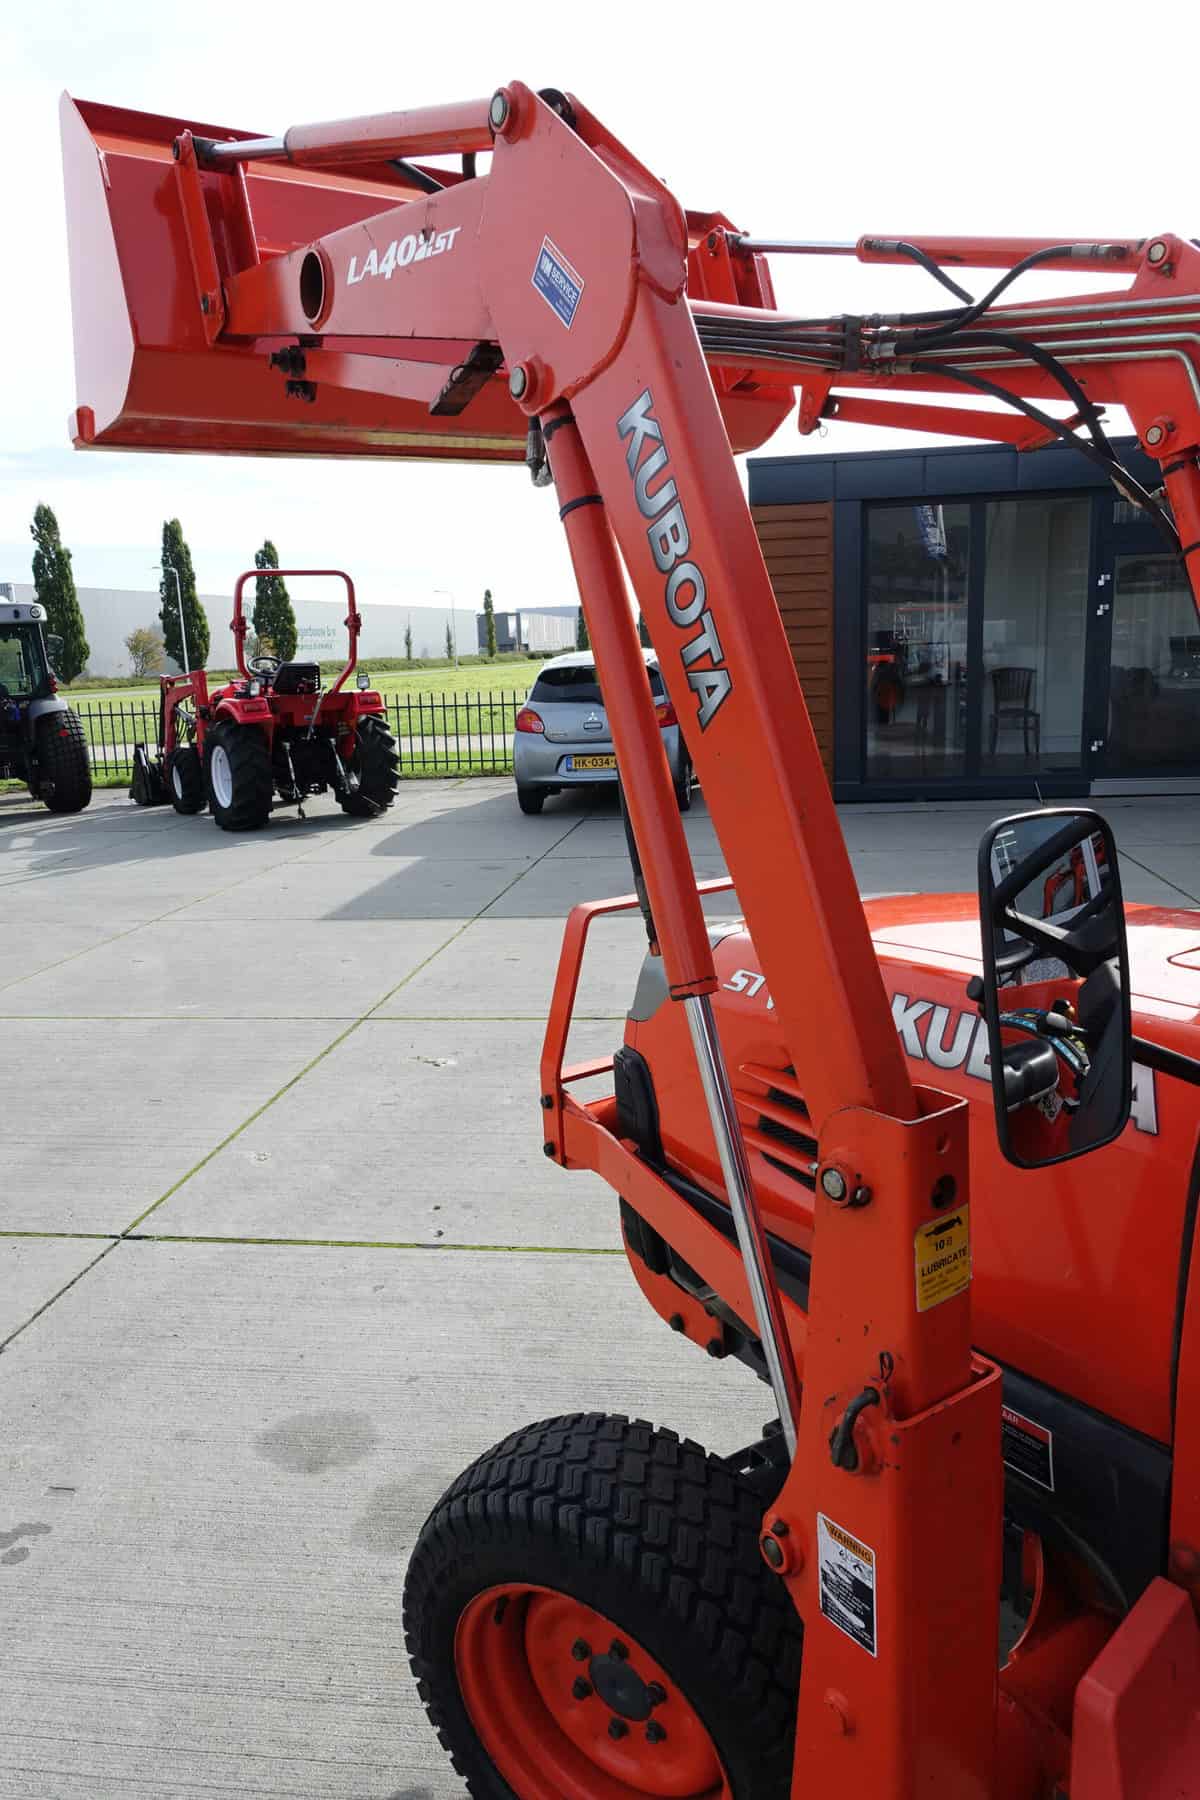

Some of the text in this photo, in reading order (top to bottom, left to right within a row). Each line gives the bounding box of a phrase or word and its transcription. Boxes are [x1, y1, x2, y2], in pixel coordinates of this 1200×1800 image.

[551, 267, 578, 304] SERVICE
[617, 387, 733, 734] KUBOTA
[574, 757, 617, 769] HK-034-
[722, 967, 775, 1010] ST
[921, 1246, 968, 1278] LUBRICATE
[829, 1523, 873, 1563] WARNING
